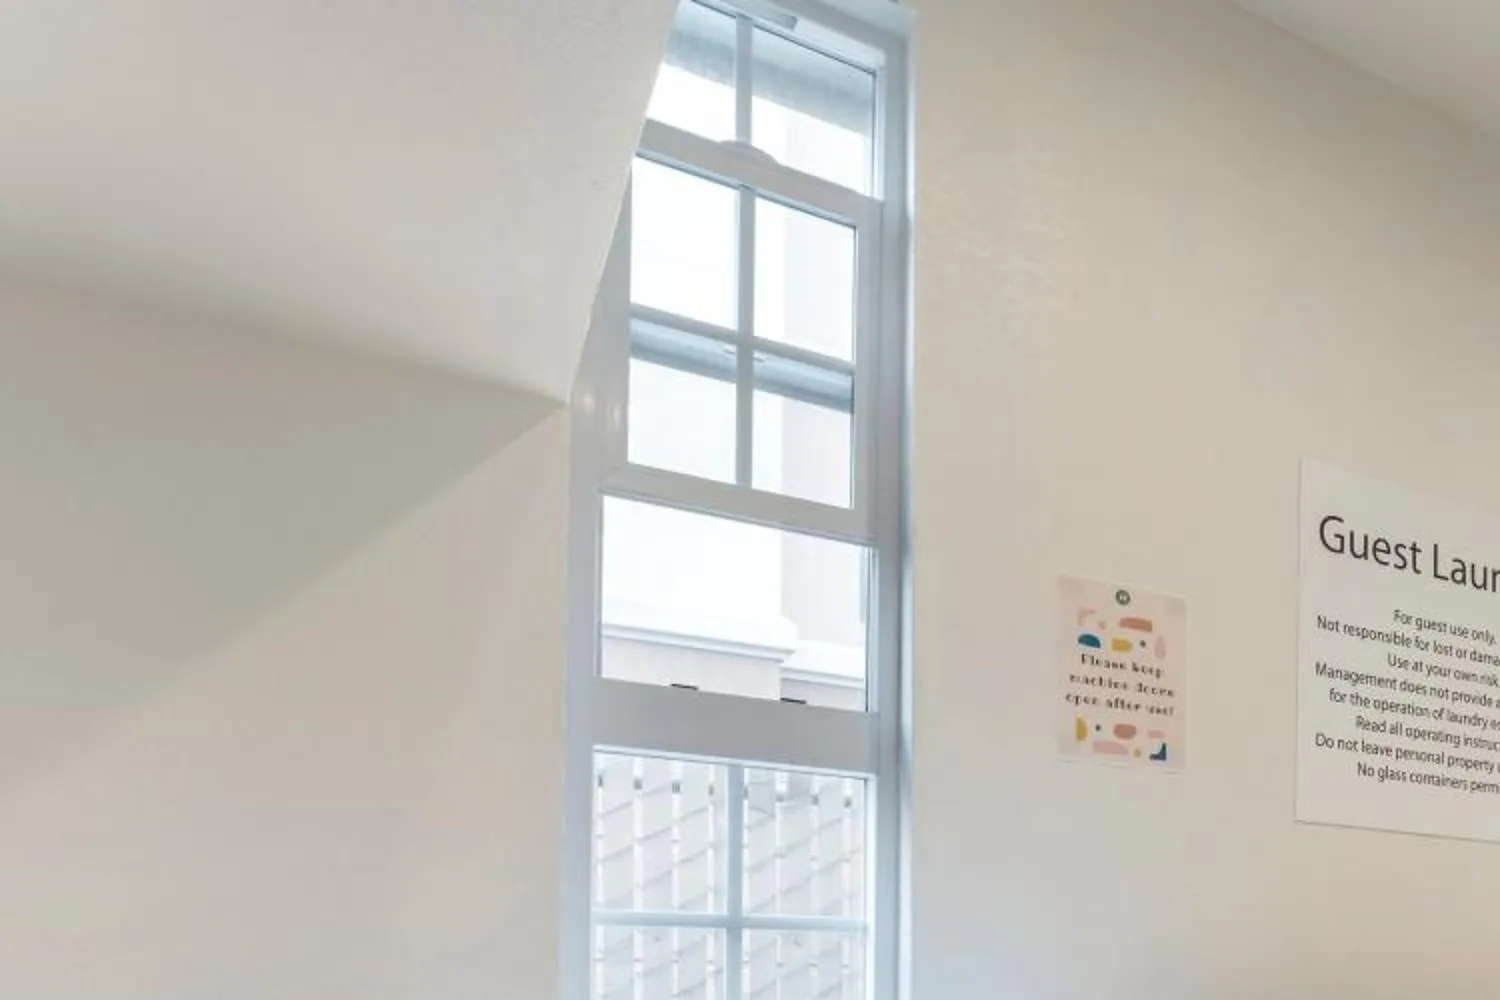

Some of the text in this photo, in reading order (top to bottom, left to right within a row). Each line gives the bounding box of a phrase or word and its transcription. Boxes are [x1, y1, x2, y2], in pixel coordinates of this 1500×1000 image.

[1318, 515, 1423, 575] Guest
[1317, 614, 1341, 633] Not
[1343, 623, 1413, 649] responsible
[1414, 635, 1431, 652] for
[1433, 639, 1454, 657] lost
[1455, 647, 1468, 660] or
[1393, 609, 1497, 647] For guest use only.
[1081, 653, 1162, 679] Please keep
[1314, 661, 1398, 691] Management
[1399, 679, 1428, 696] does
[1429, 686, 1449, 701] not
[1451, 689, 1494, 708] provide
[1386, 651, 1410, 671] Use
[1411, 660, 1424, 674] at
[1425, 663, 1452, 678] your
[1453, 668, 1479, 683] own
[1105, 696, 1142, 712] after
[1328, 687, 1348, 703] for
[1349, 691, 1372, 709] the
[1372, 698, 1430, 719] operation
[1431, 707, 1446, 721] of
[1446, 709, 1489, 731] laundry
[1355, 715, 1387, 734] Read
[1388, 720, 1404, 736] all
[1405, 726, 1461, 749] operating
[1315, 731, 1335, 749] Do
[1337, 738, 1359, 753] not
[1361, 738, 1393, 757] leave
[1395, 747, 1445, 765] personal
[1447, 755, 1495, 775] property
[1357, 761, 1375, 778] No
[1377, 764, 1407, 783] glass
[1409, 772, 1469, 791] containers
